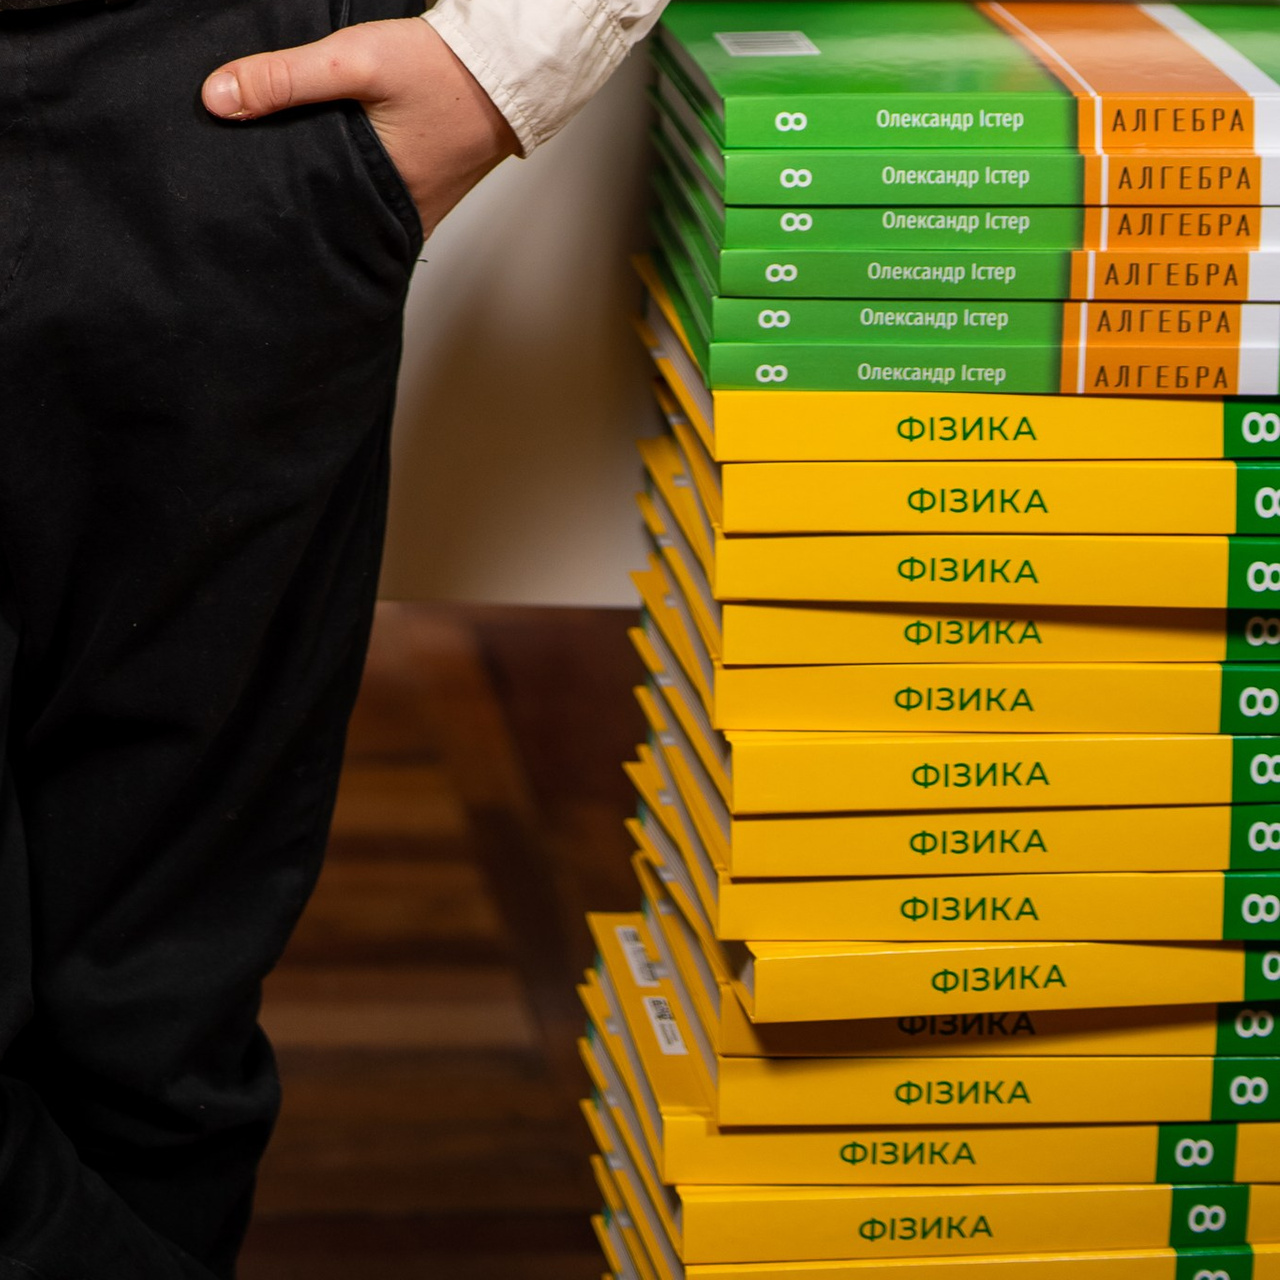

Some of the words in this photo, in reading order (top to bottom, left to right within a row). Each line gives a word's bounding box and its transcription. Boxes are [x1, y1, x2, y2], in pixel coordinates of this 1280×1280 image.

[775, 112, 807, 131] 8
[877, 110, 973, 131] Олександр
[980, 110, 1023, 131] Істер
[1113, 109, 1243, 131] АЛГЕБРА
[780, 169, 812, 187] 8
[882, 166, 979, 188] Олександр
[986, 167, 1029, 188] Істер
[1119, 167, 1250, 189] АЛГЕБРА
[781, 213, 812, 231] 8
[883, 211, 979, 233] Олександр
[986, 212, 1029, 233] Істер
[1118, 213, 1249, 236] АЛГЕБРА
[766, 264, 797, 282] 8
[868, 263, 965, 283] Олександр
[972, 263, 1015, 283] Істер
[1105, 263, 1237, 286] АЛГЕБРА
[758, 310, 790, 328] 8
[860, 308, 957, 329] Олександр
[964, 309, 1008, 330] Істер
[1097, 310, 1230, 333] АЛГЕБРА
[756, 365, 787, 382] 8
[858, 363, 955, 384] Олександр
[962, 365, 1005, 385] Істер
[1095, 366, 1227, 388] АЛГЕБРА
[897, 417, 1036, 441] ФІЗИКА
[908, 488, 1048, 513] ФІЗИКА
[898, 557, 1038, 583] ФІЗИКА
[904, 619, 1042, 647] ФІЗИКА
[895, 687, 1033, 711] ФІЗИКА
[912, 762, 1049, 788] ФІЗИКА
[910, 830, 1047, 855] ФІЗИКА
[901, 897, 1038, 921] ФІЗИКА
[932, 965, 1066, 993] ФІЗИКА
[897, 1012, 1035, 1035] ФІЗИКА
[895, 1081, 1030, 1105] ФІЗИКА
[840, 1142, 975, 1165] ФІЗИКА
[859, 1216, 992, 1241] ФІЗИКА
